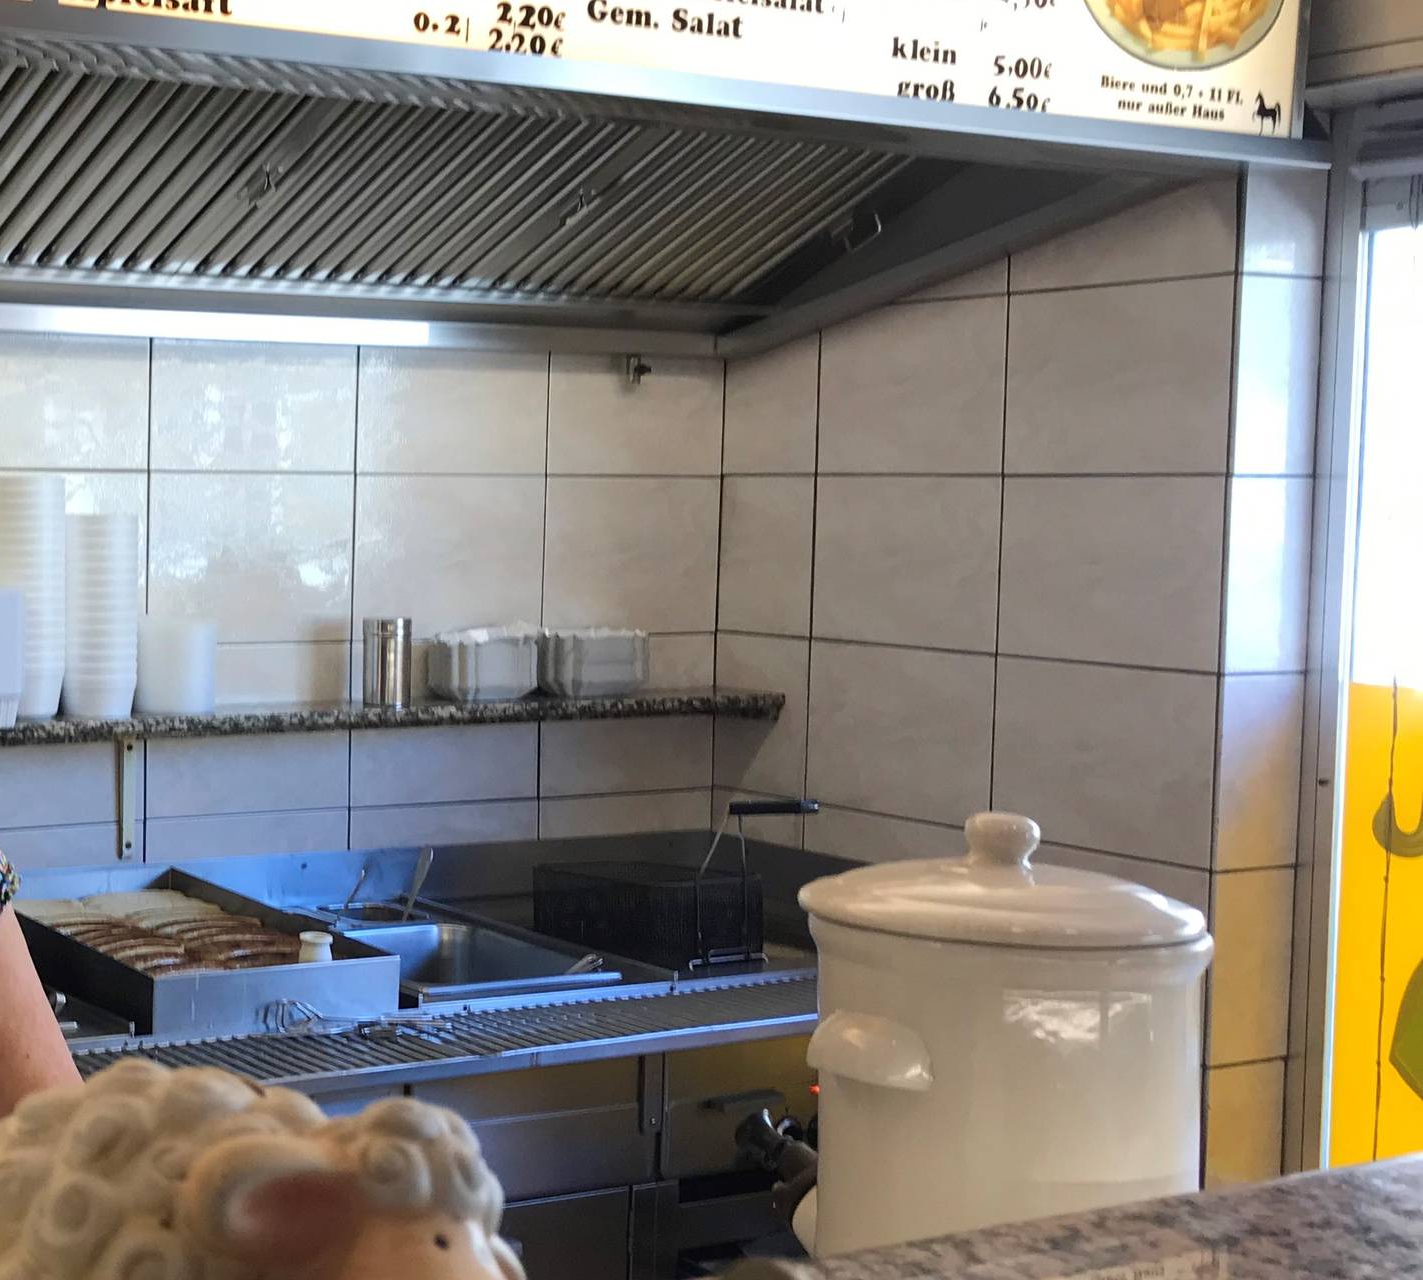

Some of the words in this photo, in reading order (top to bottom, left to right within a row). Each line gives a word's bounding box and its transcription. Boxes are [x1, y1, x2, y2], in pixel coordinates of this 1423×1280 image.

[587, 0, 659, 29] Gem.
[671, 8, 743, 38] Salat
[891, 36, 957, 65] klein
[1101, 75, 1135, 92] Biere
[1141, 82, 1167, 96] und
[1118, 98, 1142, 111] nur
[1148, 102, 1187, 117] außer
[1192, 105, 1225, 121] Haus
